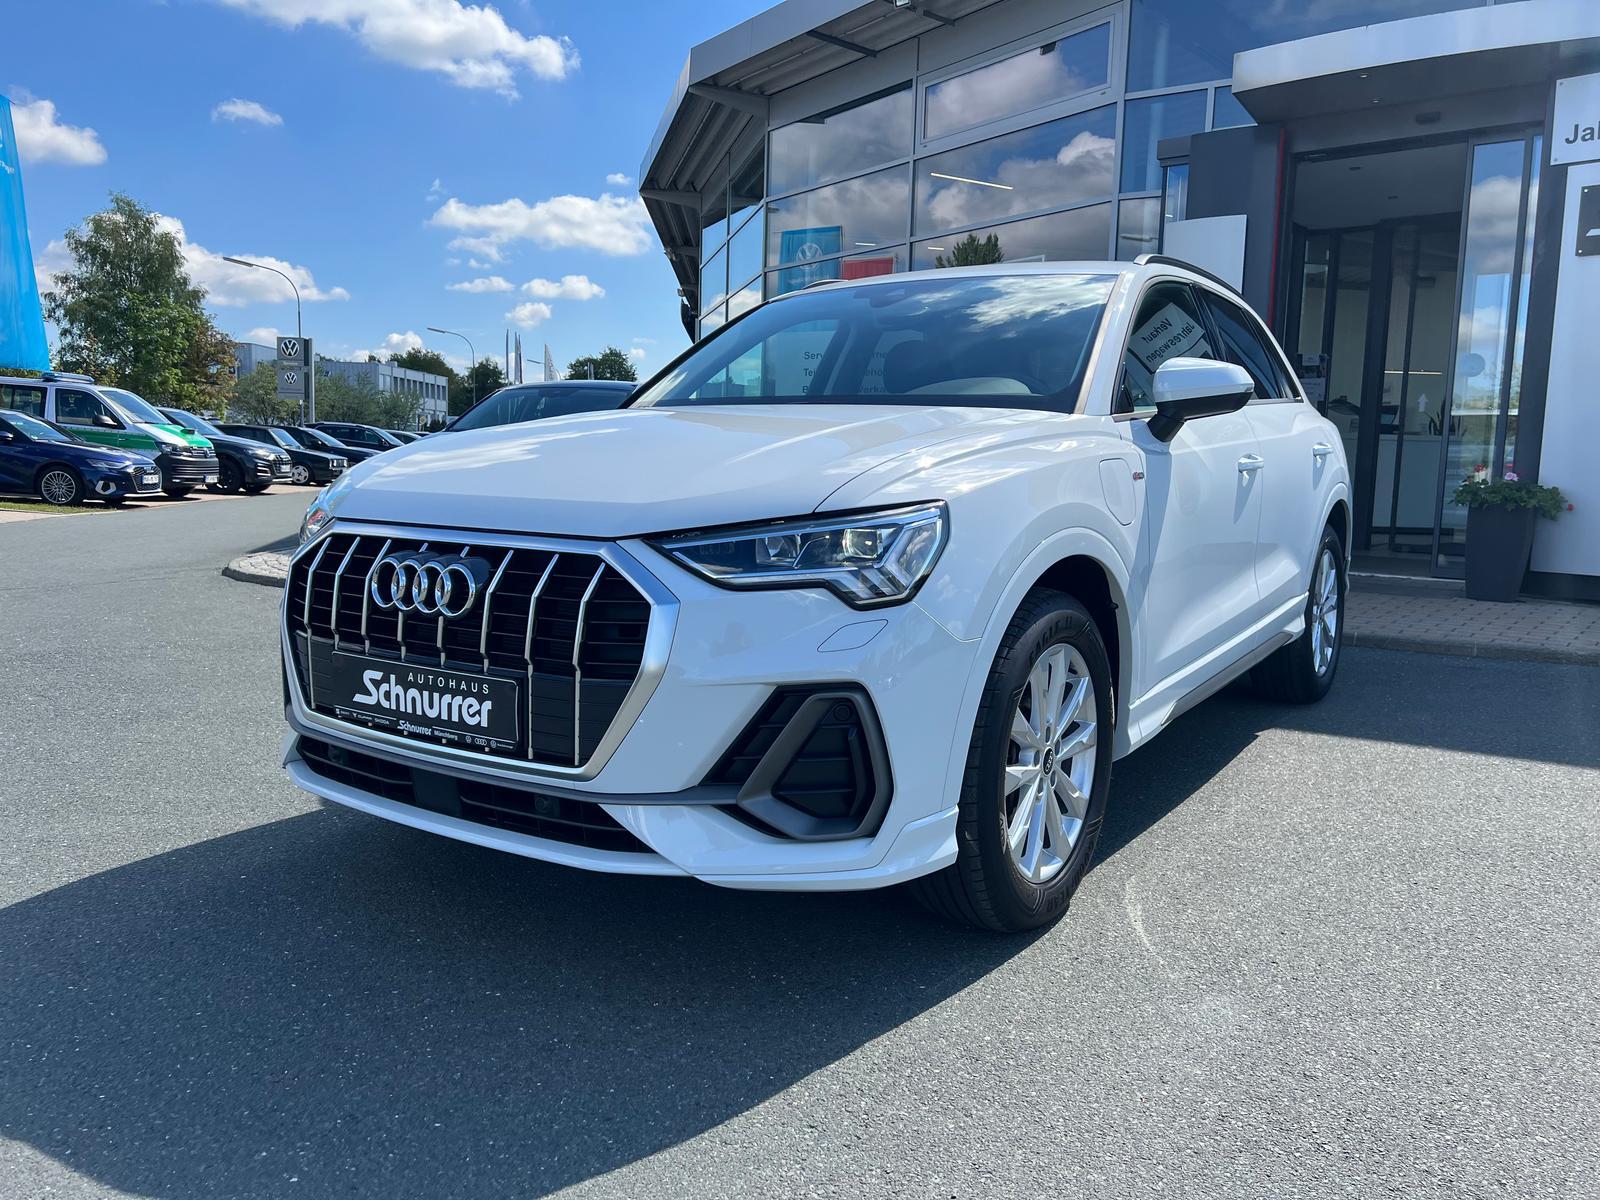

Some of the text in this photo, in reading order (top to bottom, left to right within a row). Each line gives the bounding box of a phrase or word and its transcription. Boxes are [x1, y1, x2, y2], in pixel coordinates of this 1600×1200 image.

[407, 672, 489, 694] AUTOHAUS
[352, 669, 492, 728] Schnurrer
[397, 720, 432, 735] Schnurrer
